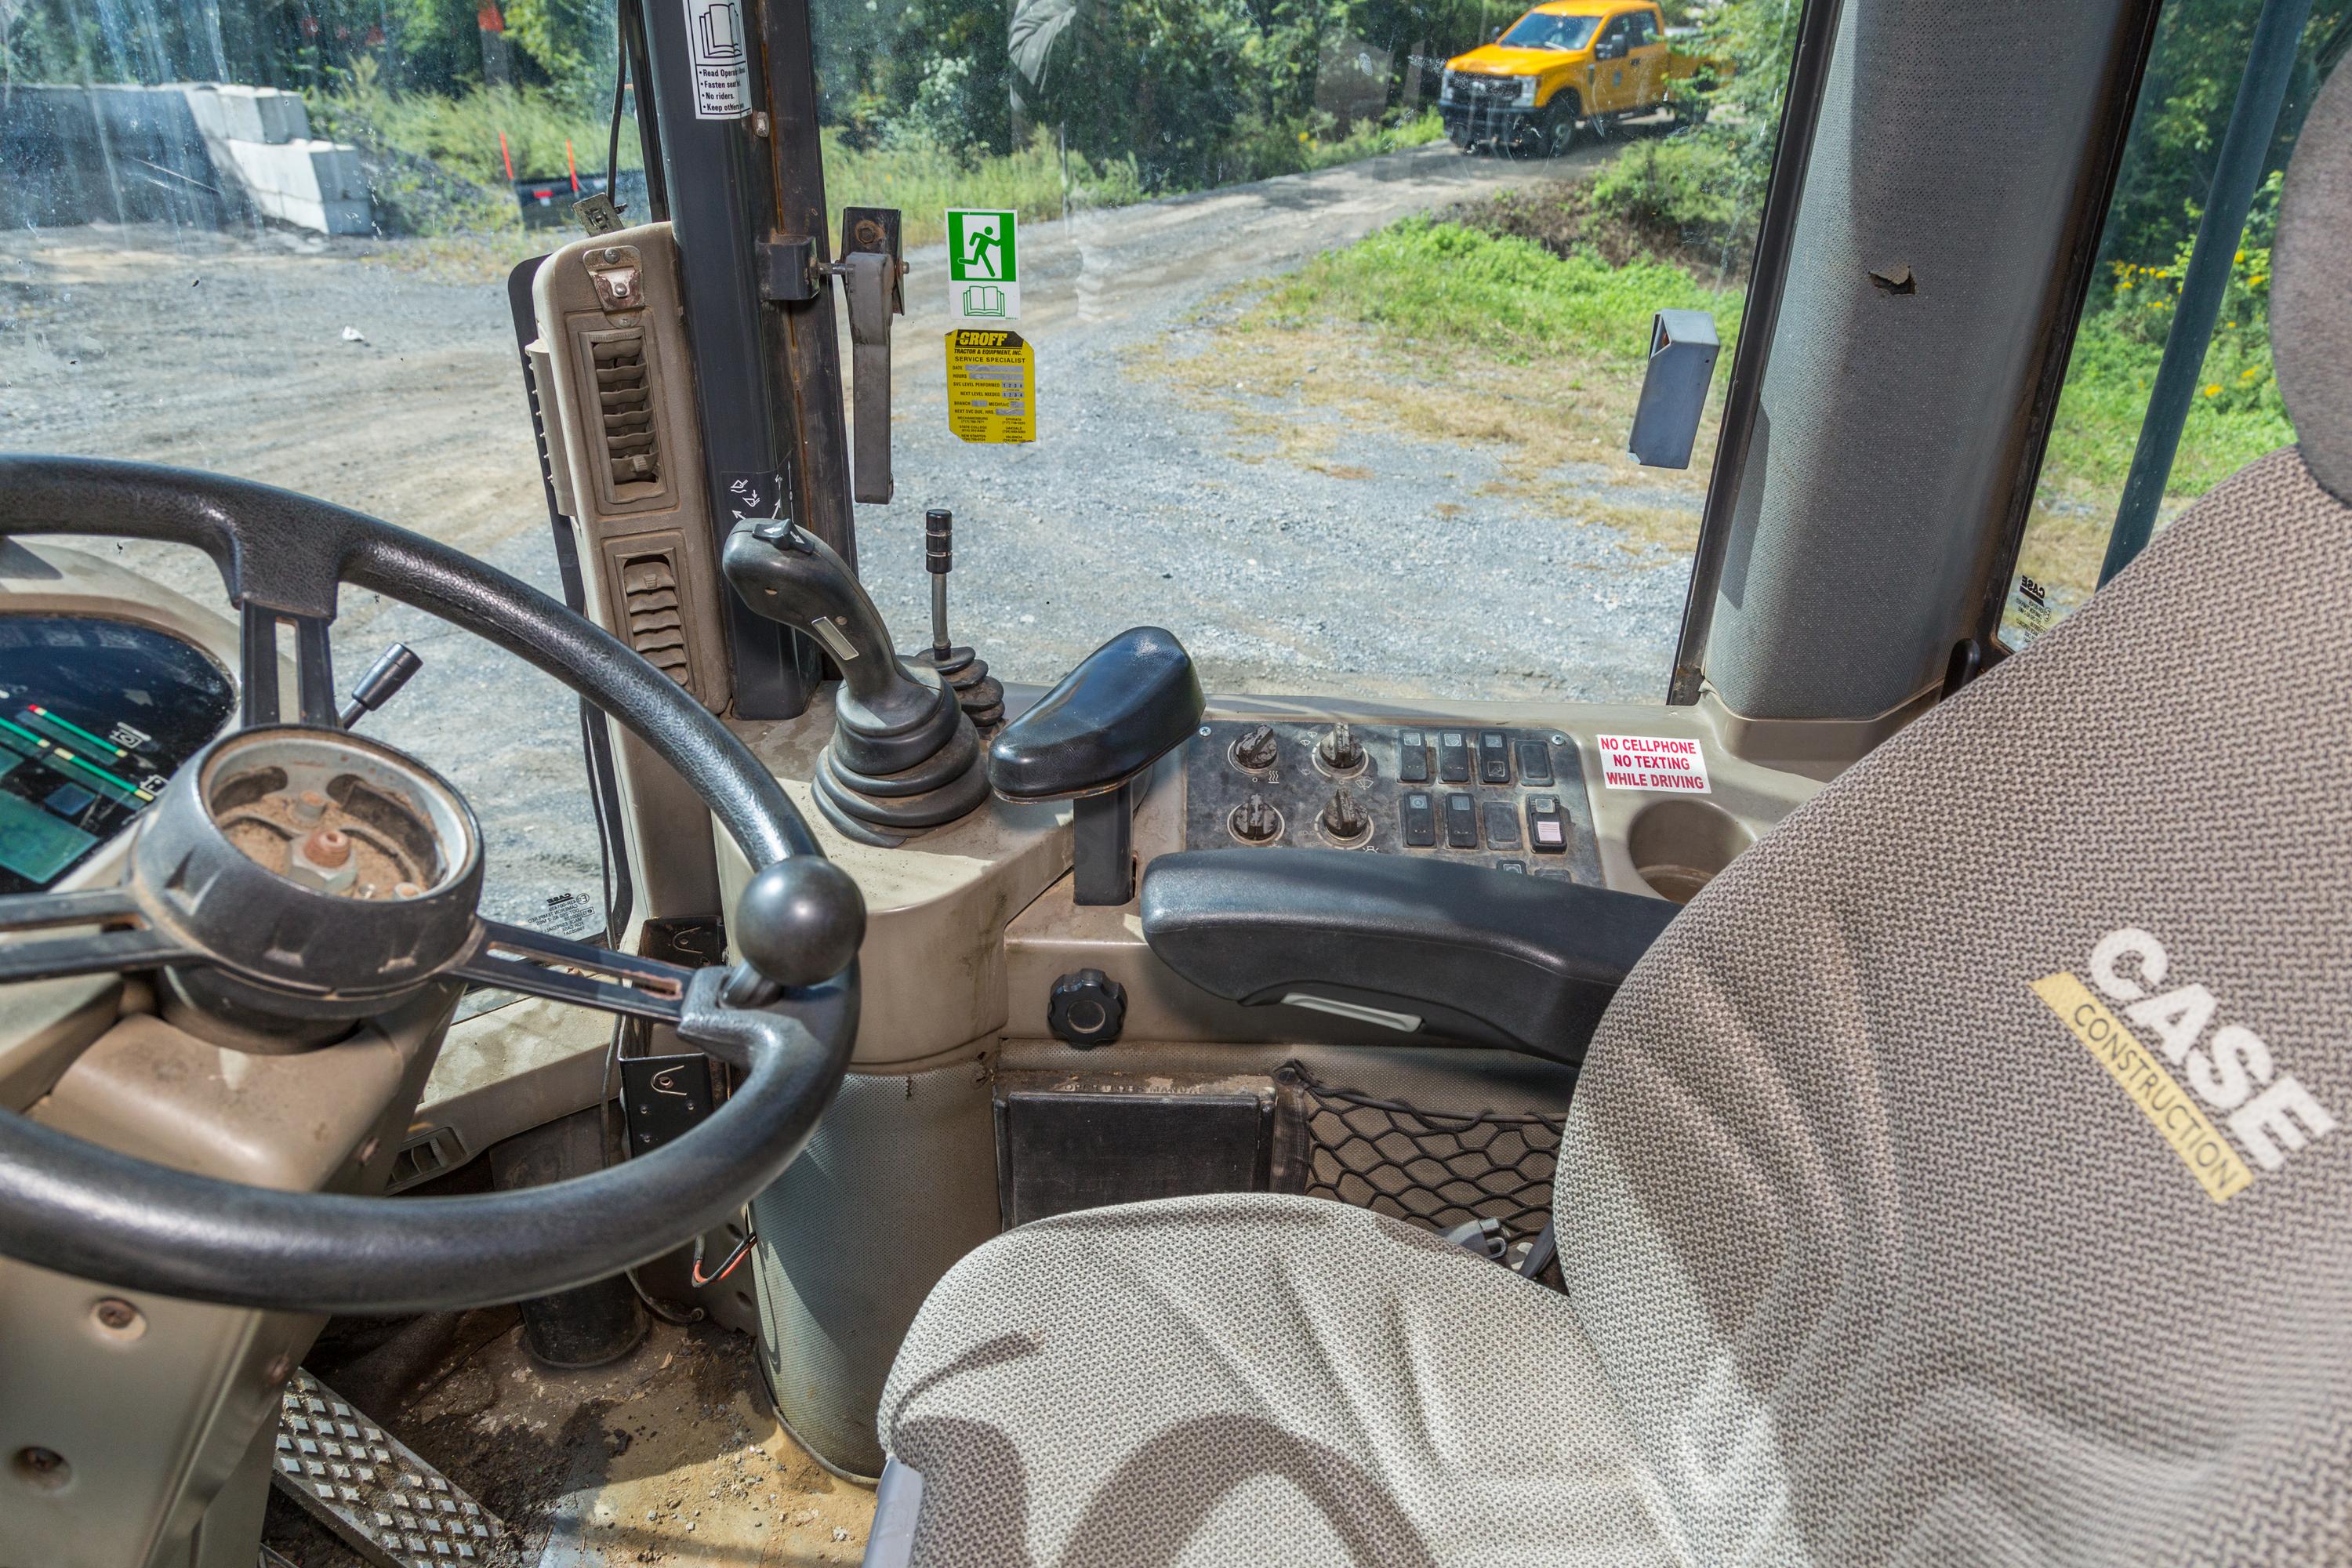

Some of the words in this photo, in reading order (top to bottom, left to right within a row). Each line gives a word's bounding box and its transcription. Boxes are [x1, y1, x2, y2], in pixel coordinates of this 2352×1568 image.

[706, 103, 722, 112] Keep
[1601, 738, 1618, 750] NO
[1622, 739, 1697, 754] CELLPHONE
[1613, 754, 1632, 768] NO
[1634, 755, 1690, 770] TEXTING
[1606, 771, 1648, 786] WHILE
[1650, 774, 1704, 789] DRIVING
[2090, 927, 2338, 1171] CASE
[2073, 1003, 2239, 1189] CONSTRUCTION
